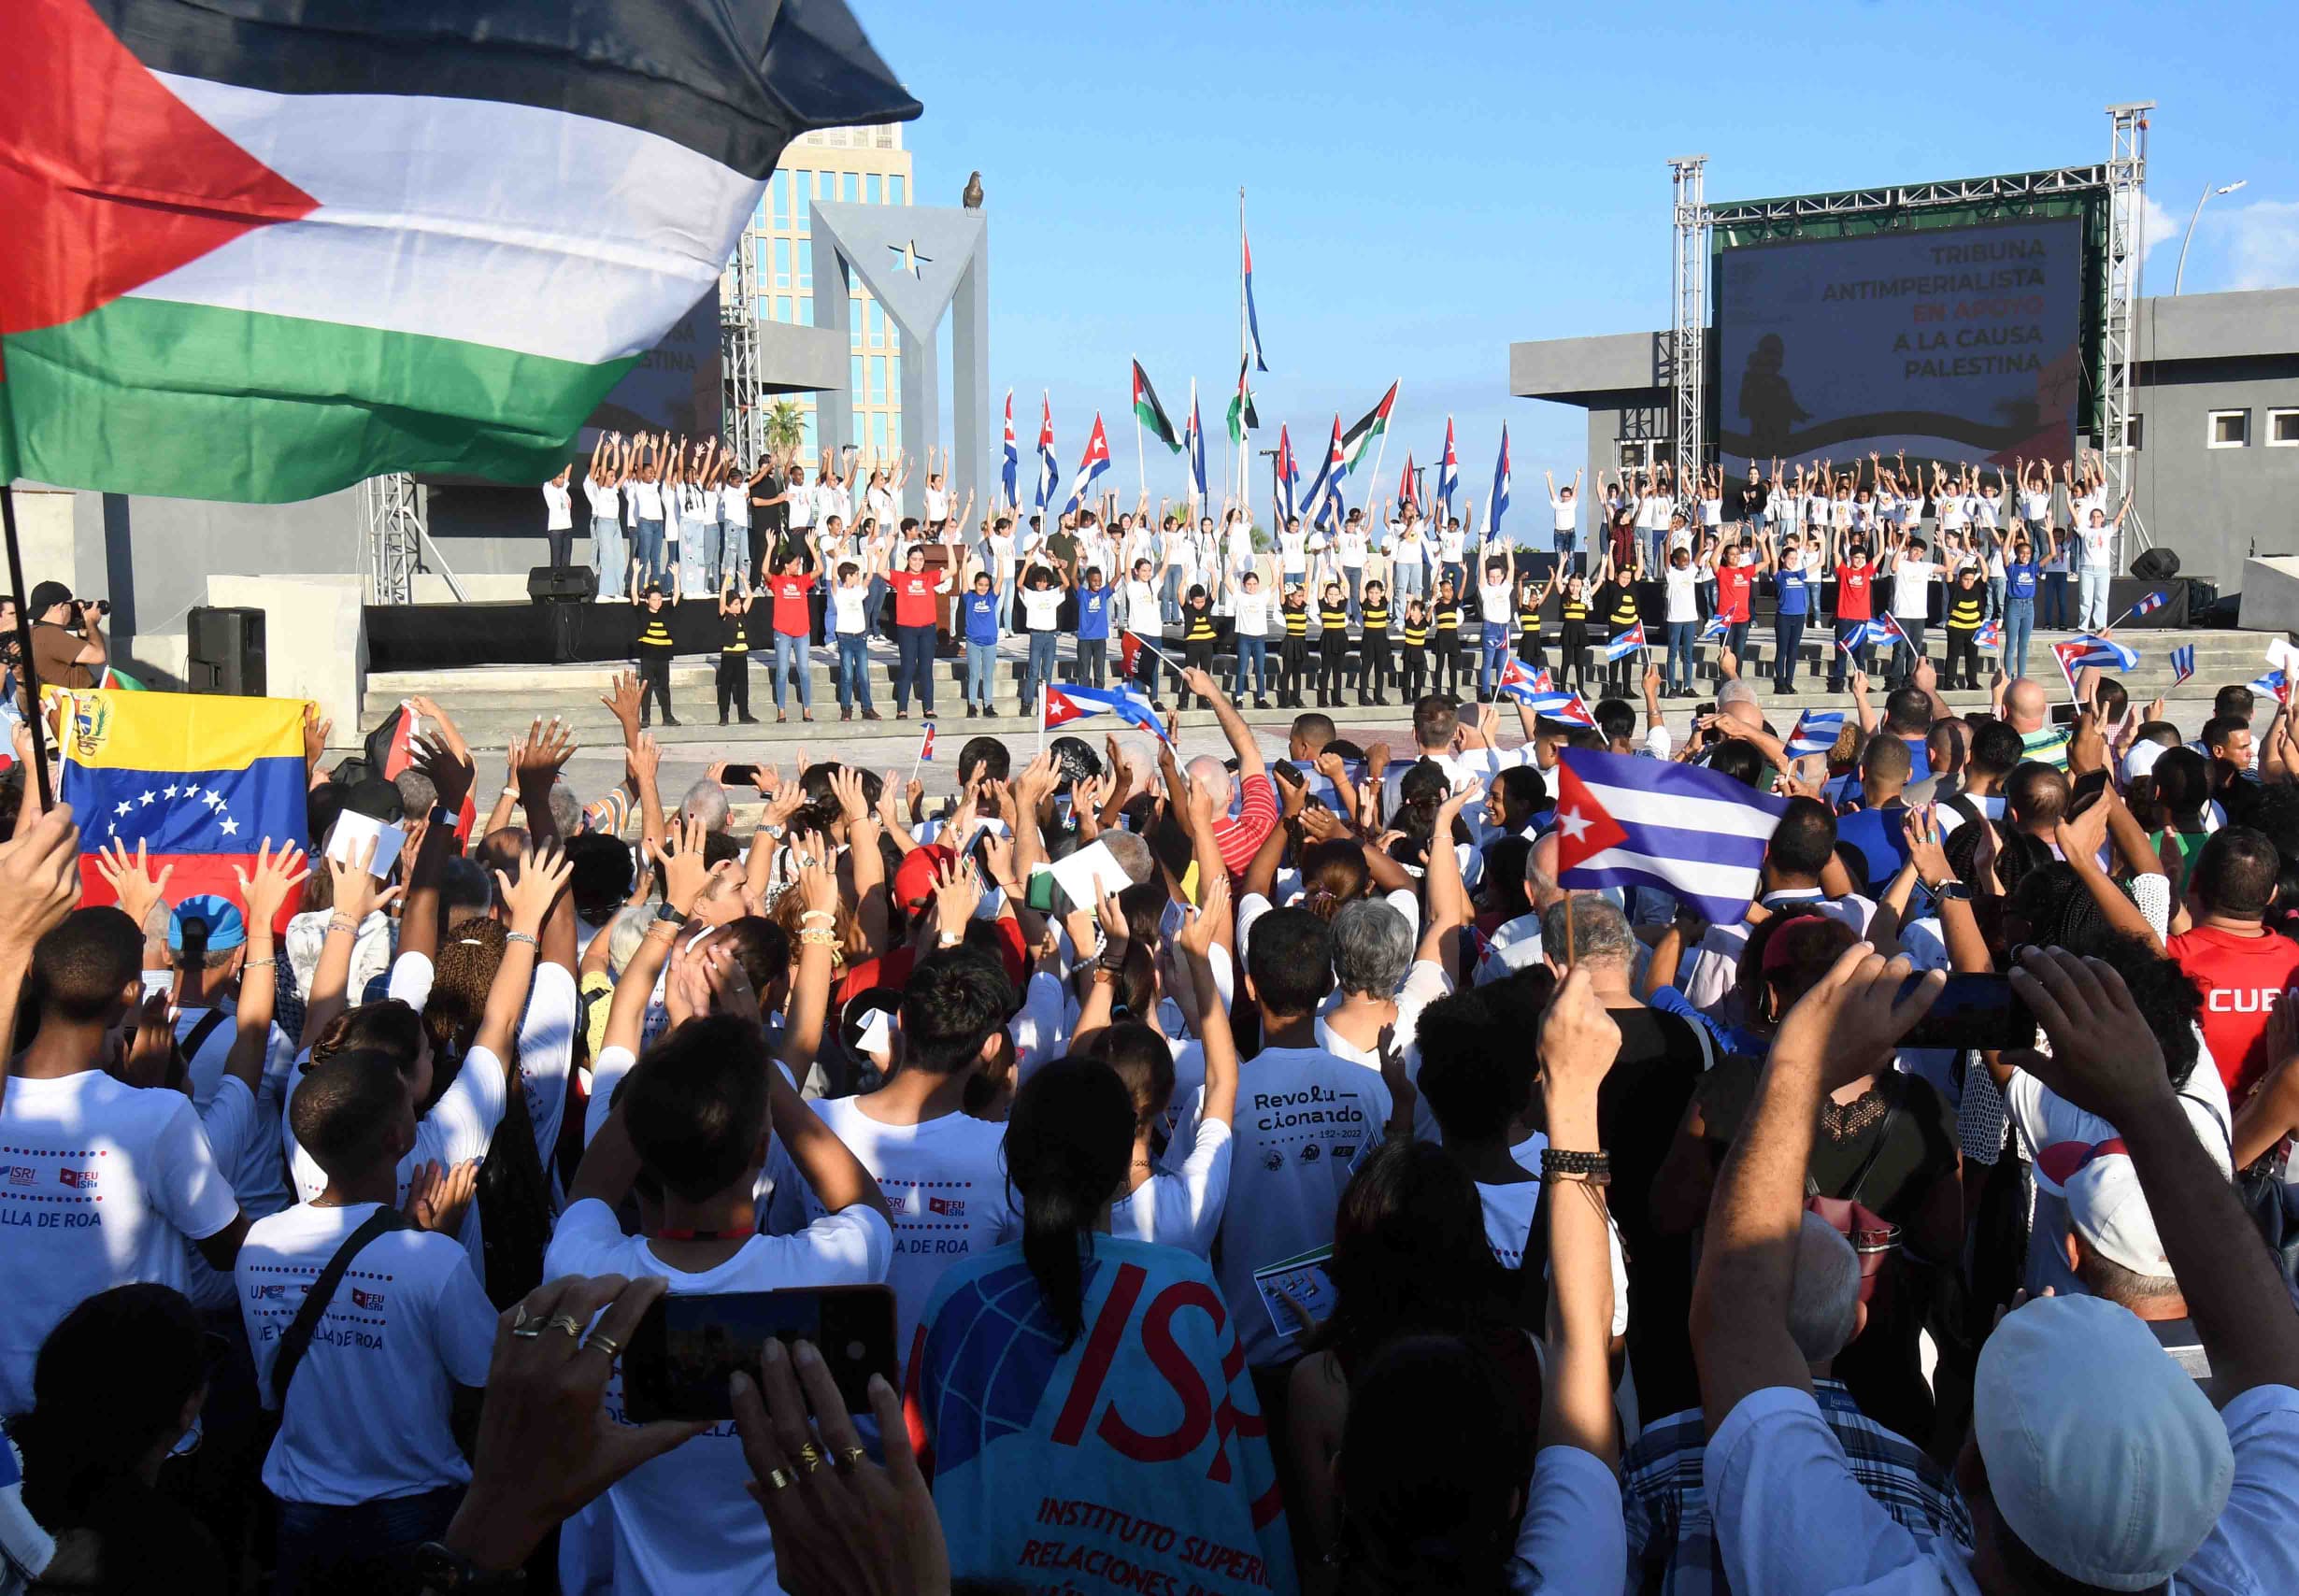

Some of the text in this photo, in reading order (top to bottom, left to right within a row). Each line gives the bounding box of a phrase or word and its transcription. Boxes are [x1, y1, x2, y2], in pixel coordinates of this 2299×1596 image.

[1930, 238, 2047, 266] TRIBUNA
[1821, 267, 2046, 302] ANTIMPERIALISTA
[1913, 296, 2045, 324] EN APOYO
[1893, 325, 2044, 352] A LA CAUSA
[1905, 353, 2043, 379] PALESTINA
[2208, 988, 2281, 1012] CUB
[37, 1213, 60, 1228] DE
[64, 1212, 102, 1228] ROA
[910, 1240, 932, 1253] DE
[935, 1240, 969, 1253] ROA
[337, 1331, 353, 1346] DE
[356, 1332, 383, 1349] ROA
[1036, 1496, 1176, 1553] INSTITUTO
